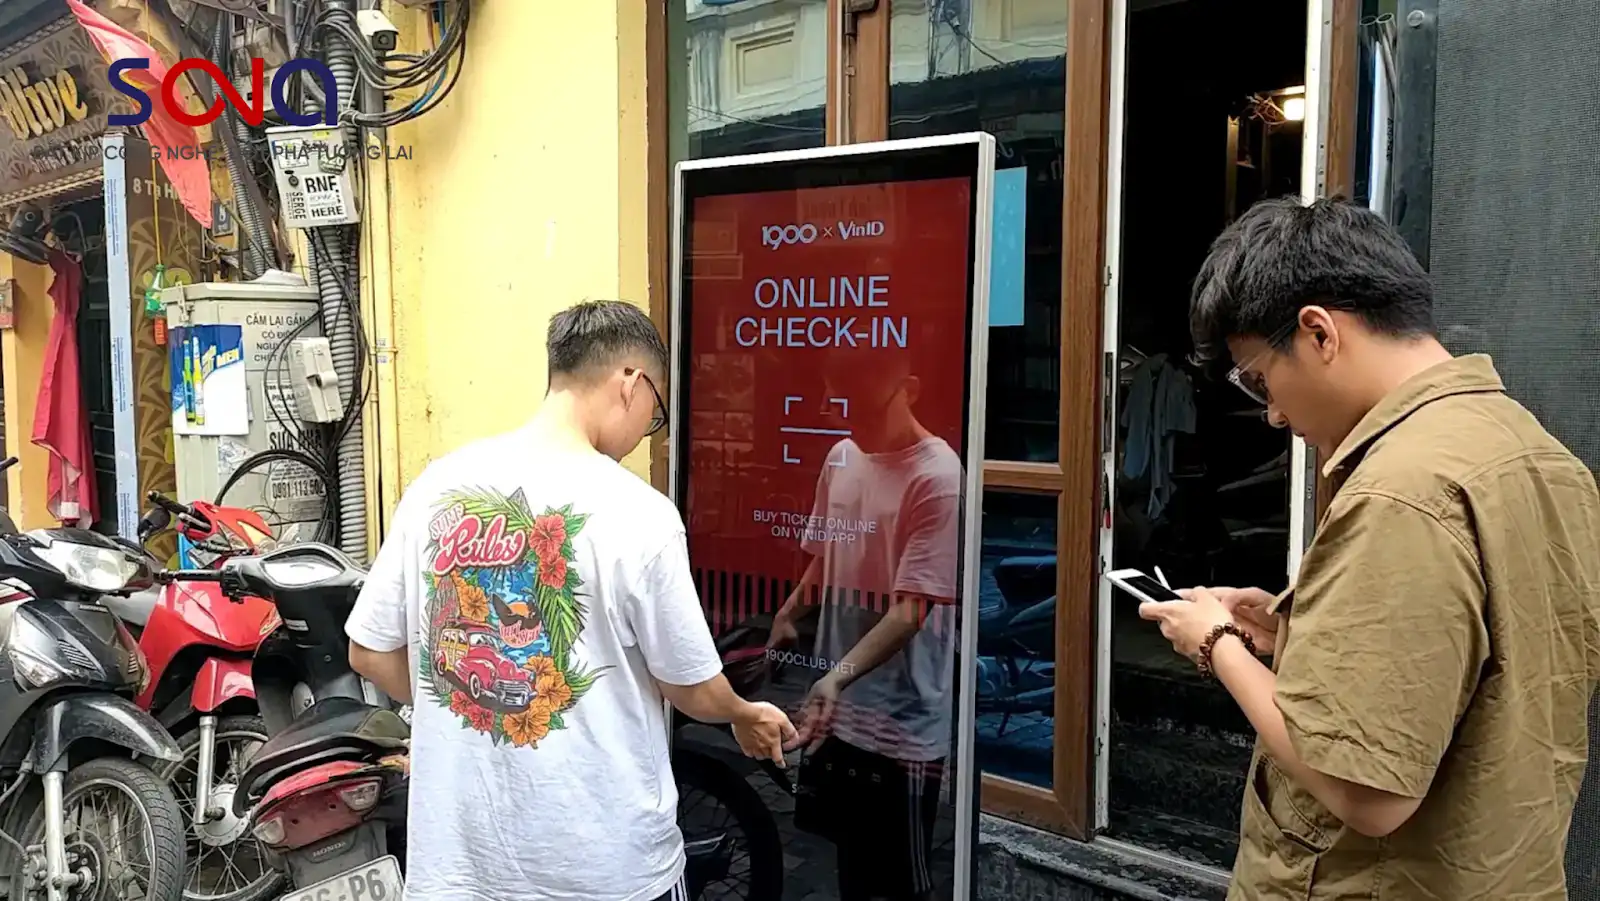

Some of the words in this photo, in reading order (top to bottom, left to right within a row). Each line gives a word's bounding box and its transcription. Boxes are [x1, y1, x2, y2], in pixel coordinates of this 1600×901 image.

[292, 192, 307, 219] SERGE
[311, 206, 344, 217] HERE
[762, 224, 817, 250] 1900
[754, 275, 890, 309] ONLINE
[735, 316, 908, 348] CHECK-IN
[753, 509, 779, 523] BUY
[780, 511, 824, 528] TICKET
[826, 517, 877, 534] ONLINE
[771, 525, 790, 538] ON
[829, 531, 856, 545] APP
[764, 648, 856, 675] 1900CLUB.NET
[312, 841, 347, 857] HONDA
